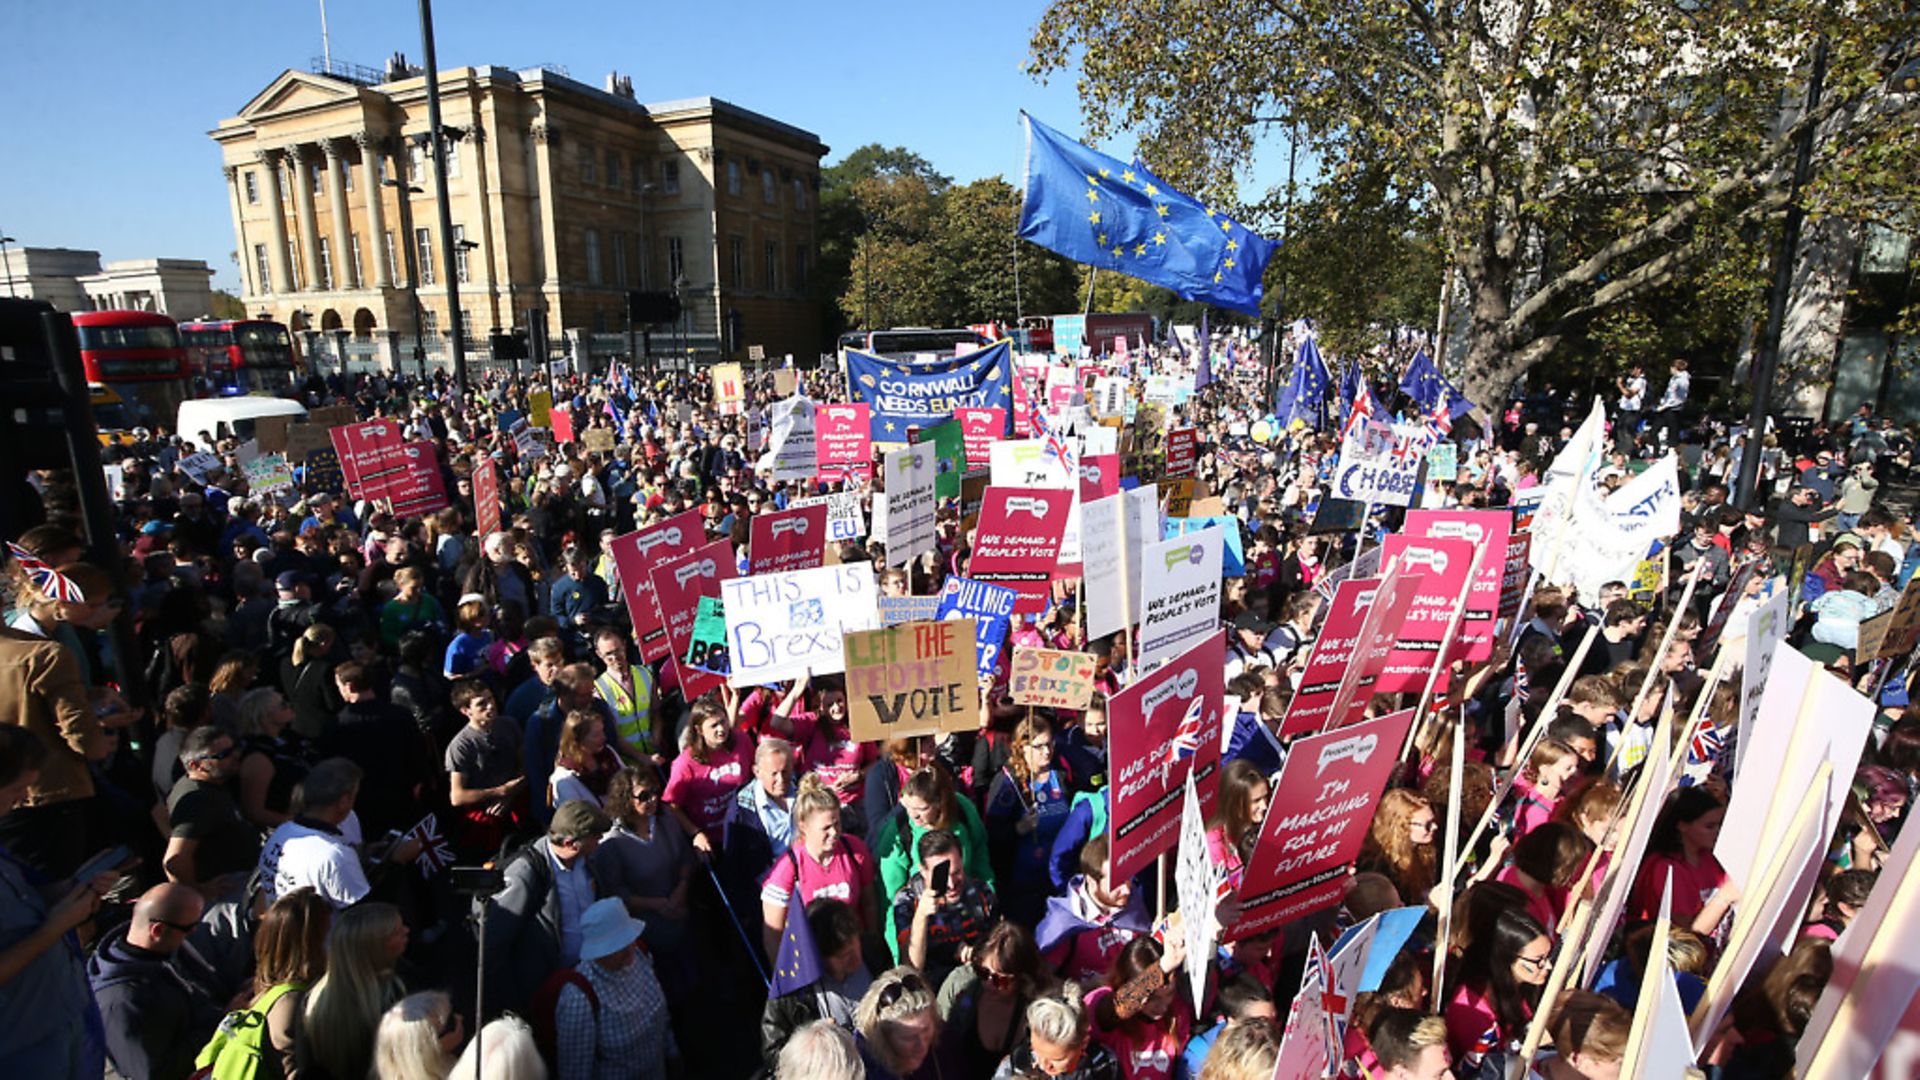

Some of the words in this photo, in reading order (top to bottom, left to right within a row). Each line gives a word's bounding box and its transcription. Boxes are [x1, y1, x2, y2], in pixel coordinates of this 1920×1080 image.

[876, 395, 928, 412] NEEDS
[930, 389, 987, 412] EUNITY
[880, 374, 978, 397] CORNWALL
[832, 519, 857, 539] EU
[981, 535, 1001, 544] WE
[1004, 536, 1047, 545] DEMAND
[1050, 536, 1056, 545] A
[976, 546, 1028, 558] PEOPLE'S
[1030, 547, 1055, 557] VOTE
[726, 572, 802, 607] THIS
[834, 566, 862, 595] IS
[942, 577, 1014, 616] PULLING
[1148, 598, 1165, 612] WE
[1169, 584, 1206, 603] DEMAND
[1210, 581, 1217, 590] A
[1473, 581, 1496, 593] OTE
[1146, 602, 1192, 626] PEOPLE'S
[1194, 594, 1218, 609] VOTE
[847, 629, 902, 667] LET
[914, 623, 955, 660] THE
[1016, 650, 1086, 677] STOP
[868, 683, 964, 725] VOTE
[1119, 755, 1145, 782] WE
[1207, 709, 1217, 725] A
[1315, 779, 1351, 803] I'M
[1274, 792, 1370, 837] MARCHING
[1282, 830, 1317, 855] FOR
[1321, 817, 1351, 840] MY
[1274, 840, 1341, 877] FUTURE
